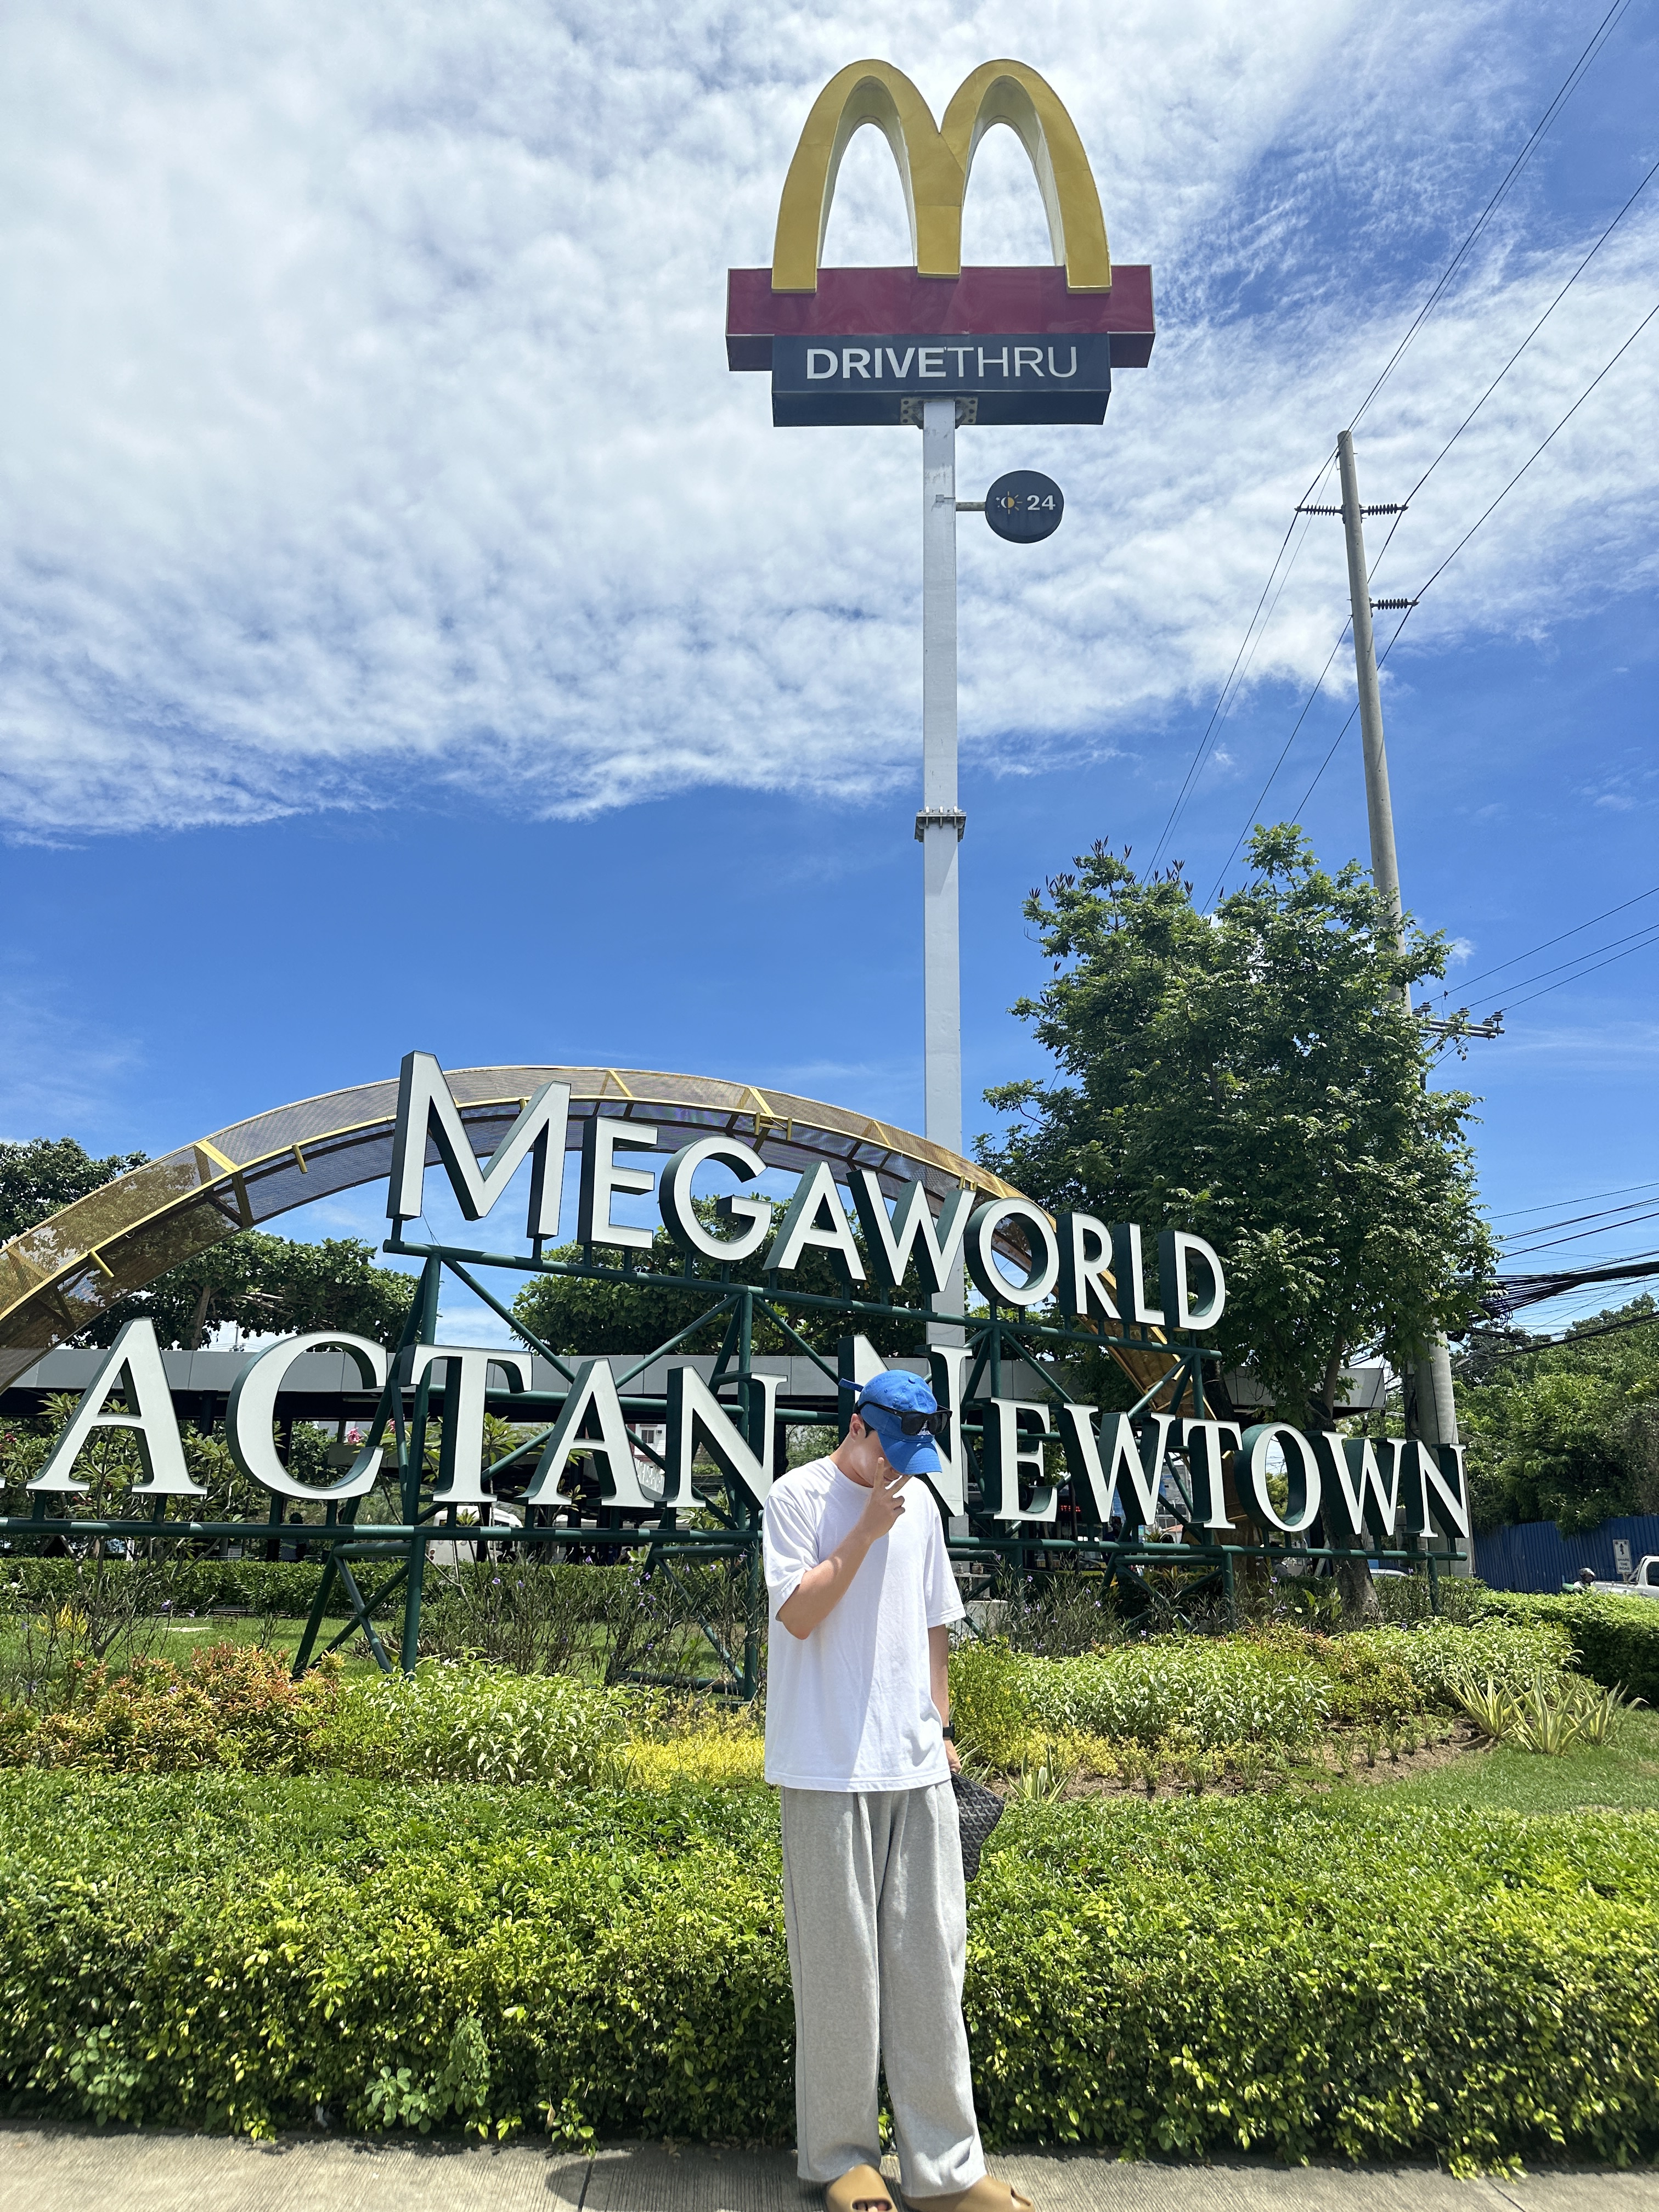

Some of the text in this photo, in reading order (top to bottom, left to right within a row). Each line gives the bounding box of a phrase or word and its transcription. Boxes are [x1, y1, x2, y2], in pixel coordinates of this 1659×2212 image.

[1027, 494, 1056, 511] 24
[386, 1050, 1226, 1330] MEGAWORLD
[0, 1317, 788, 1509] ACTAN
